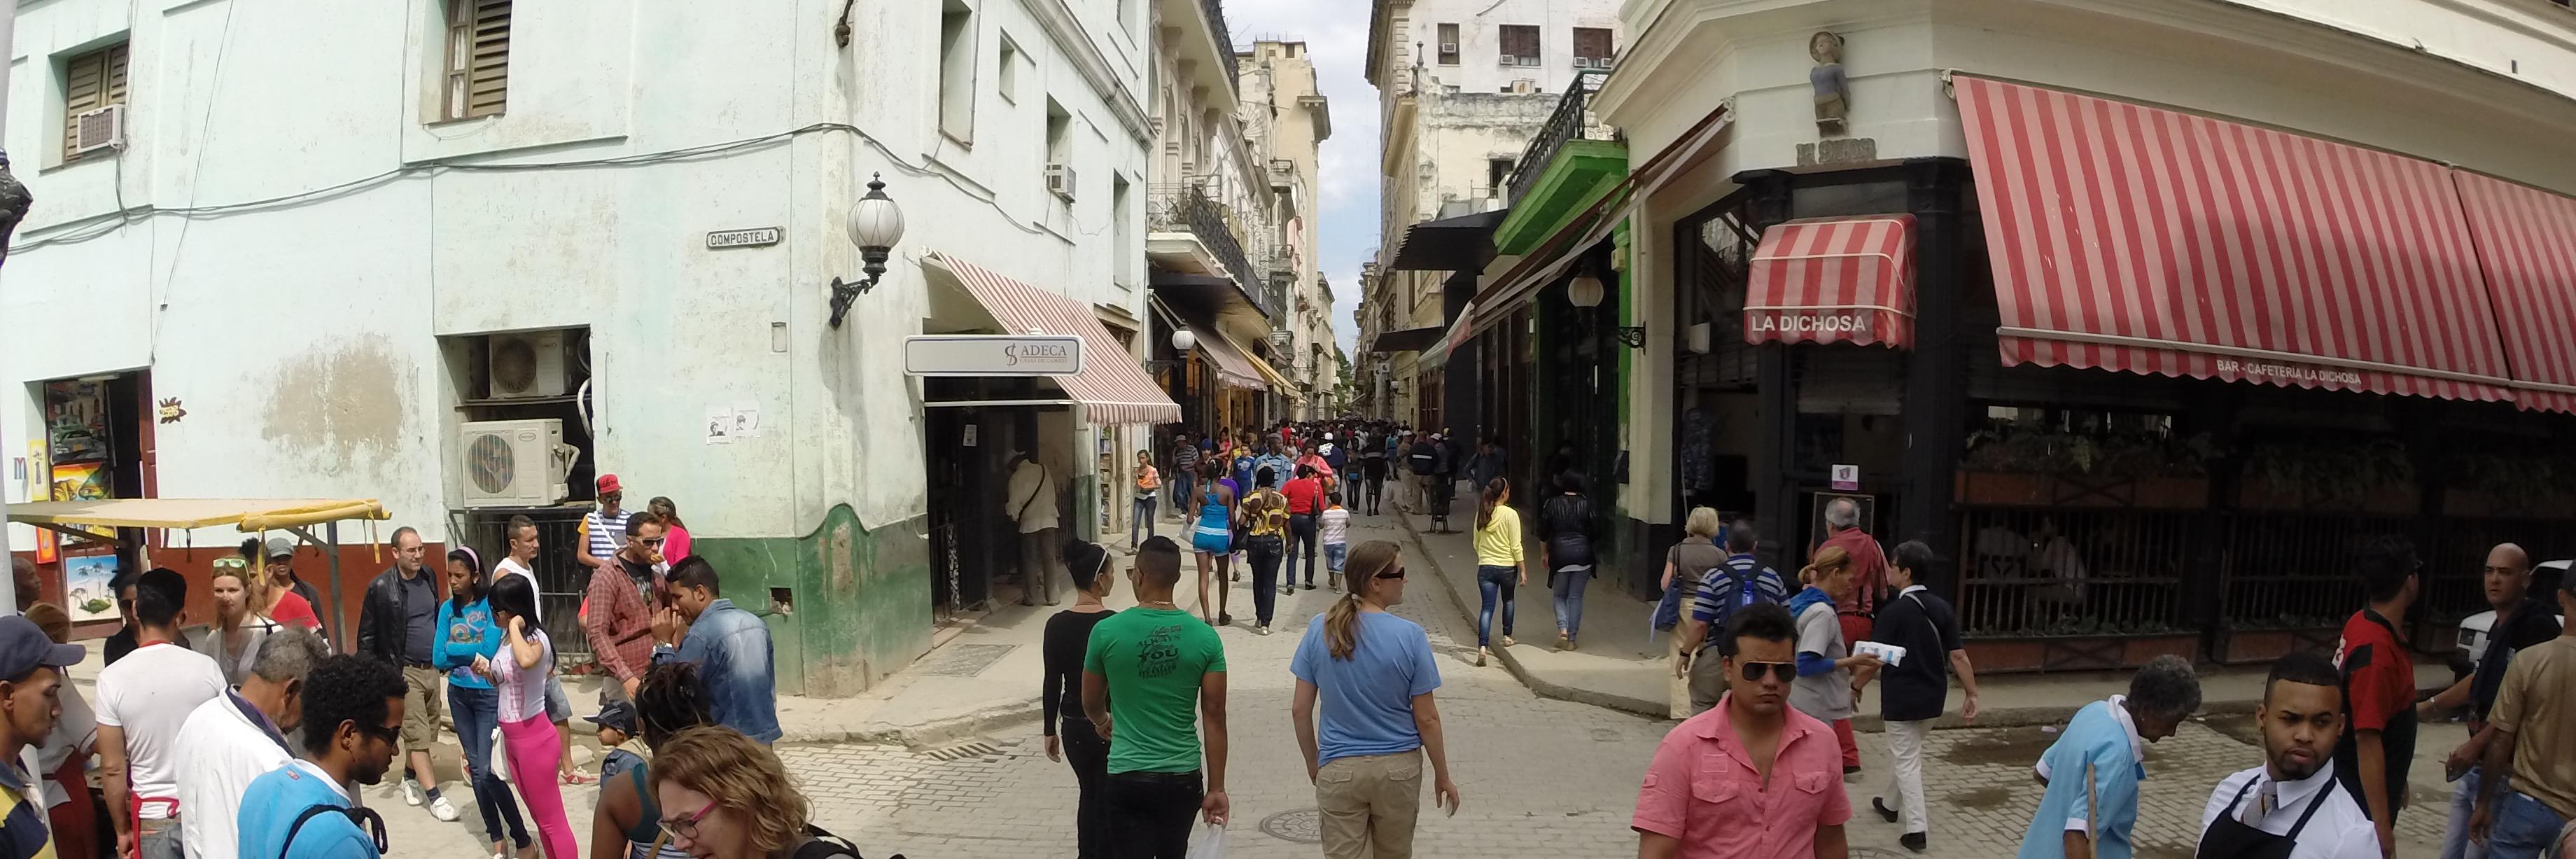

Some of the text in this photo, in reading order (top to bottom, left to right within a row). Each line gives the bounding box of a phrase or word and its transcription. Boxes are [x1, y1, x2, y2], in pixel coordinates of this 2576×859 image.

[710, 230, 774, 246] COMPOSTELA
[1752, 315, 1866, 332] LA DICHOSA
[2216, 359, 2239, 372] BAR
[2304, 369, 2318, 380] LA
[2318, 370, 2362, 384] DICHOSA
